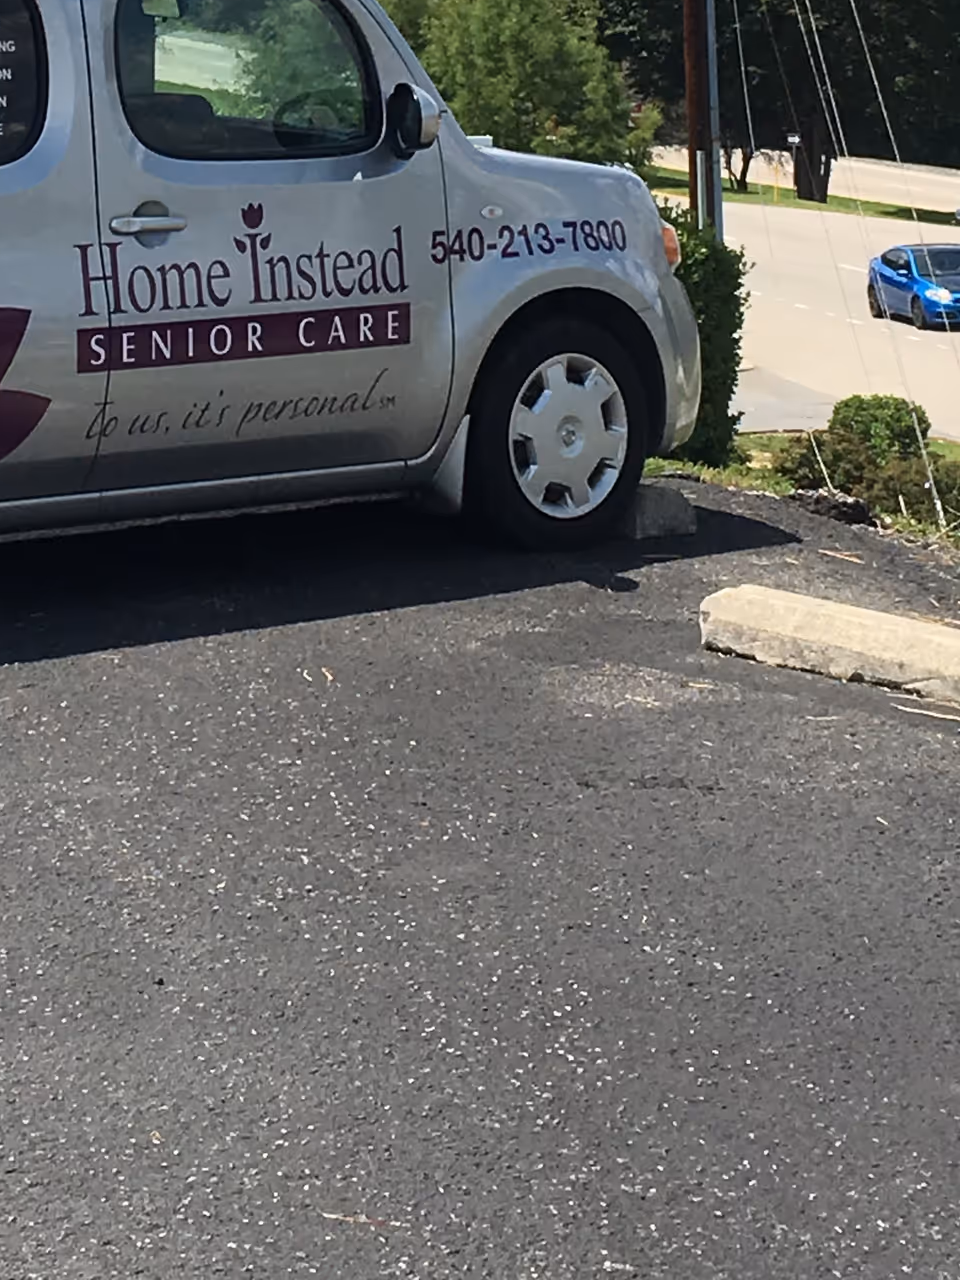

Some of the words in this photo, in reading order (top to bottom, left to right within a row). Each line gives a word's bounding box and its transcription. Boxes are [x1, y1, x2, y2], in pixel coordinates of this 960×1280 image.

[430, 220, 627, 264] 540-213-7800
[73, 241, 232, 317] Home
[246, 225, 410, 305] Instead
[90, 322, 263, 366] SENIOR
[297, 310, 400, 348] CARE
[127, 409, 170, 436] us,
[181, 389, 232, 431] it's
